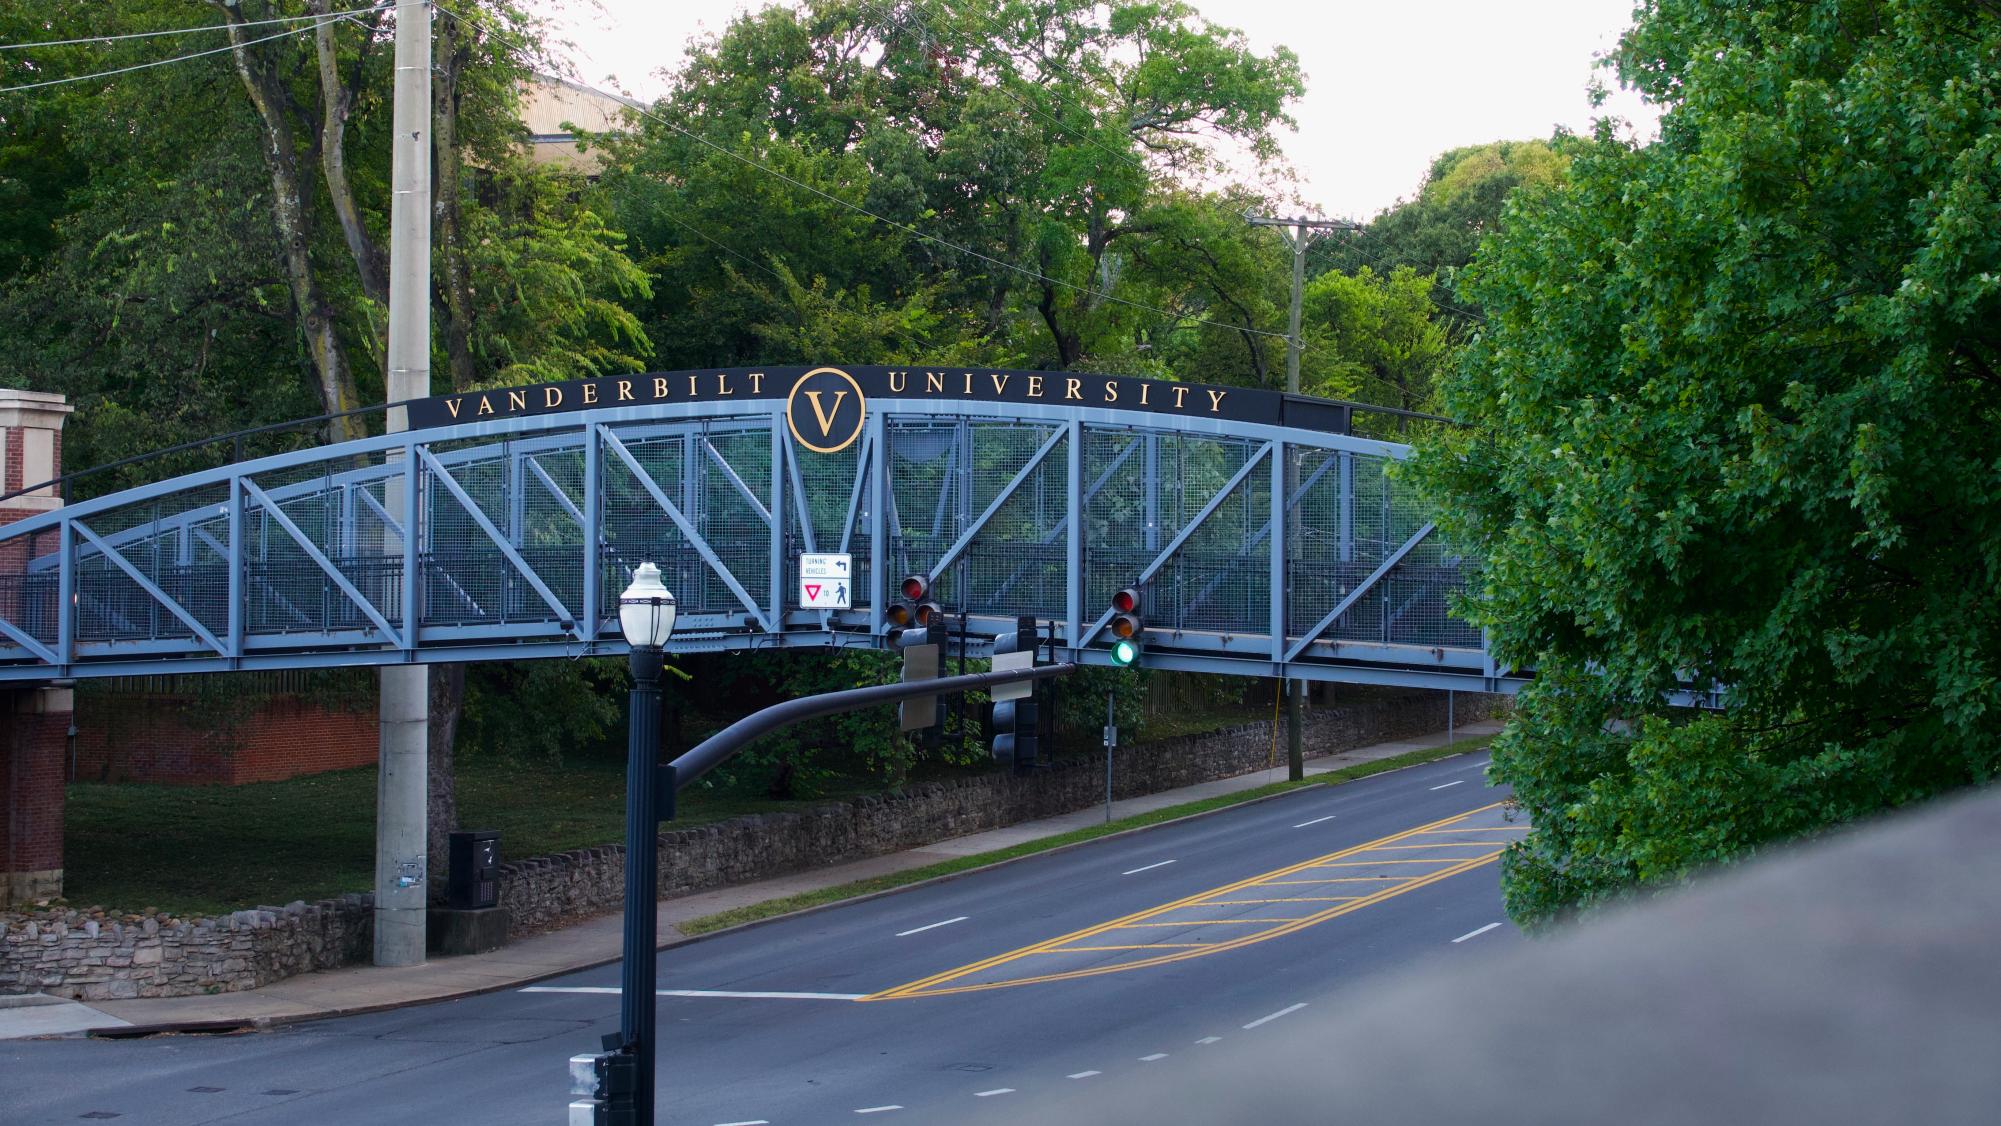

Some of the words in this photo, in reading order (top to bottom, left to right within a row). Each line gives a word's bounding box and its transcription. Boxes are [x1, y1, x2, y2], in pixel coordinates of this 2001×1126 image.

[445, 373, 765, 418] VANDERBILT
[888, 372, 1227, 412] UNIVERSITY
[804, 391, 848, 437] V
[805, 557, 827, 565] TURNING
[805, 567, 827, 575] VEHICLES
